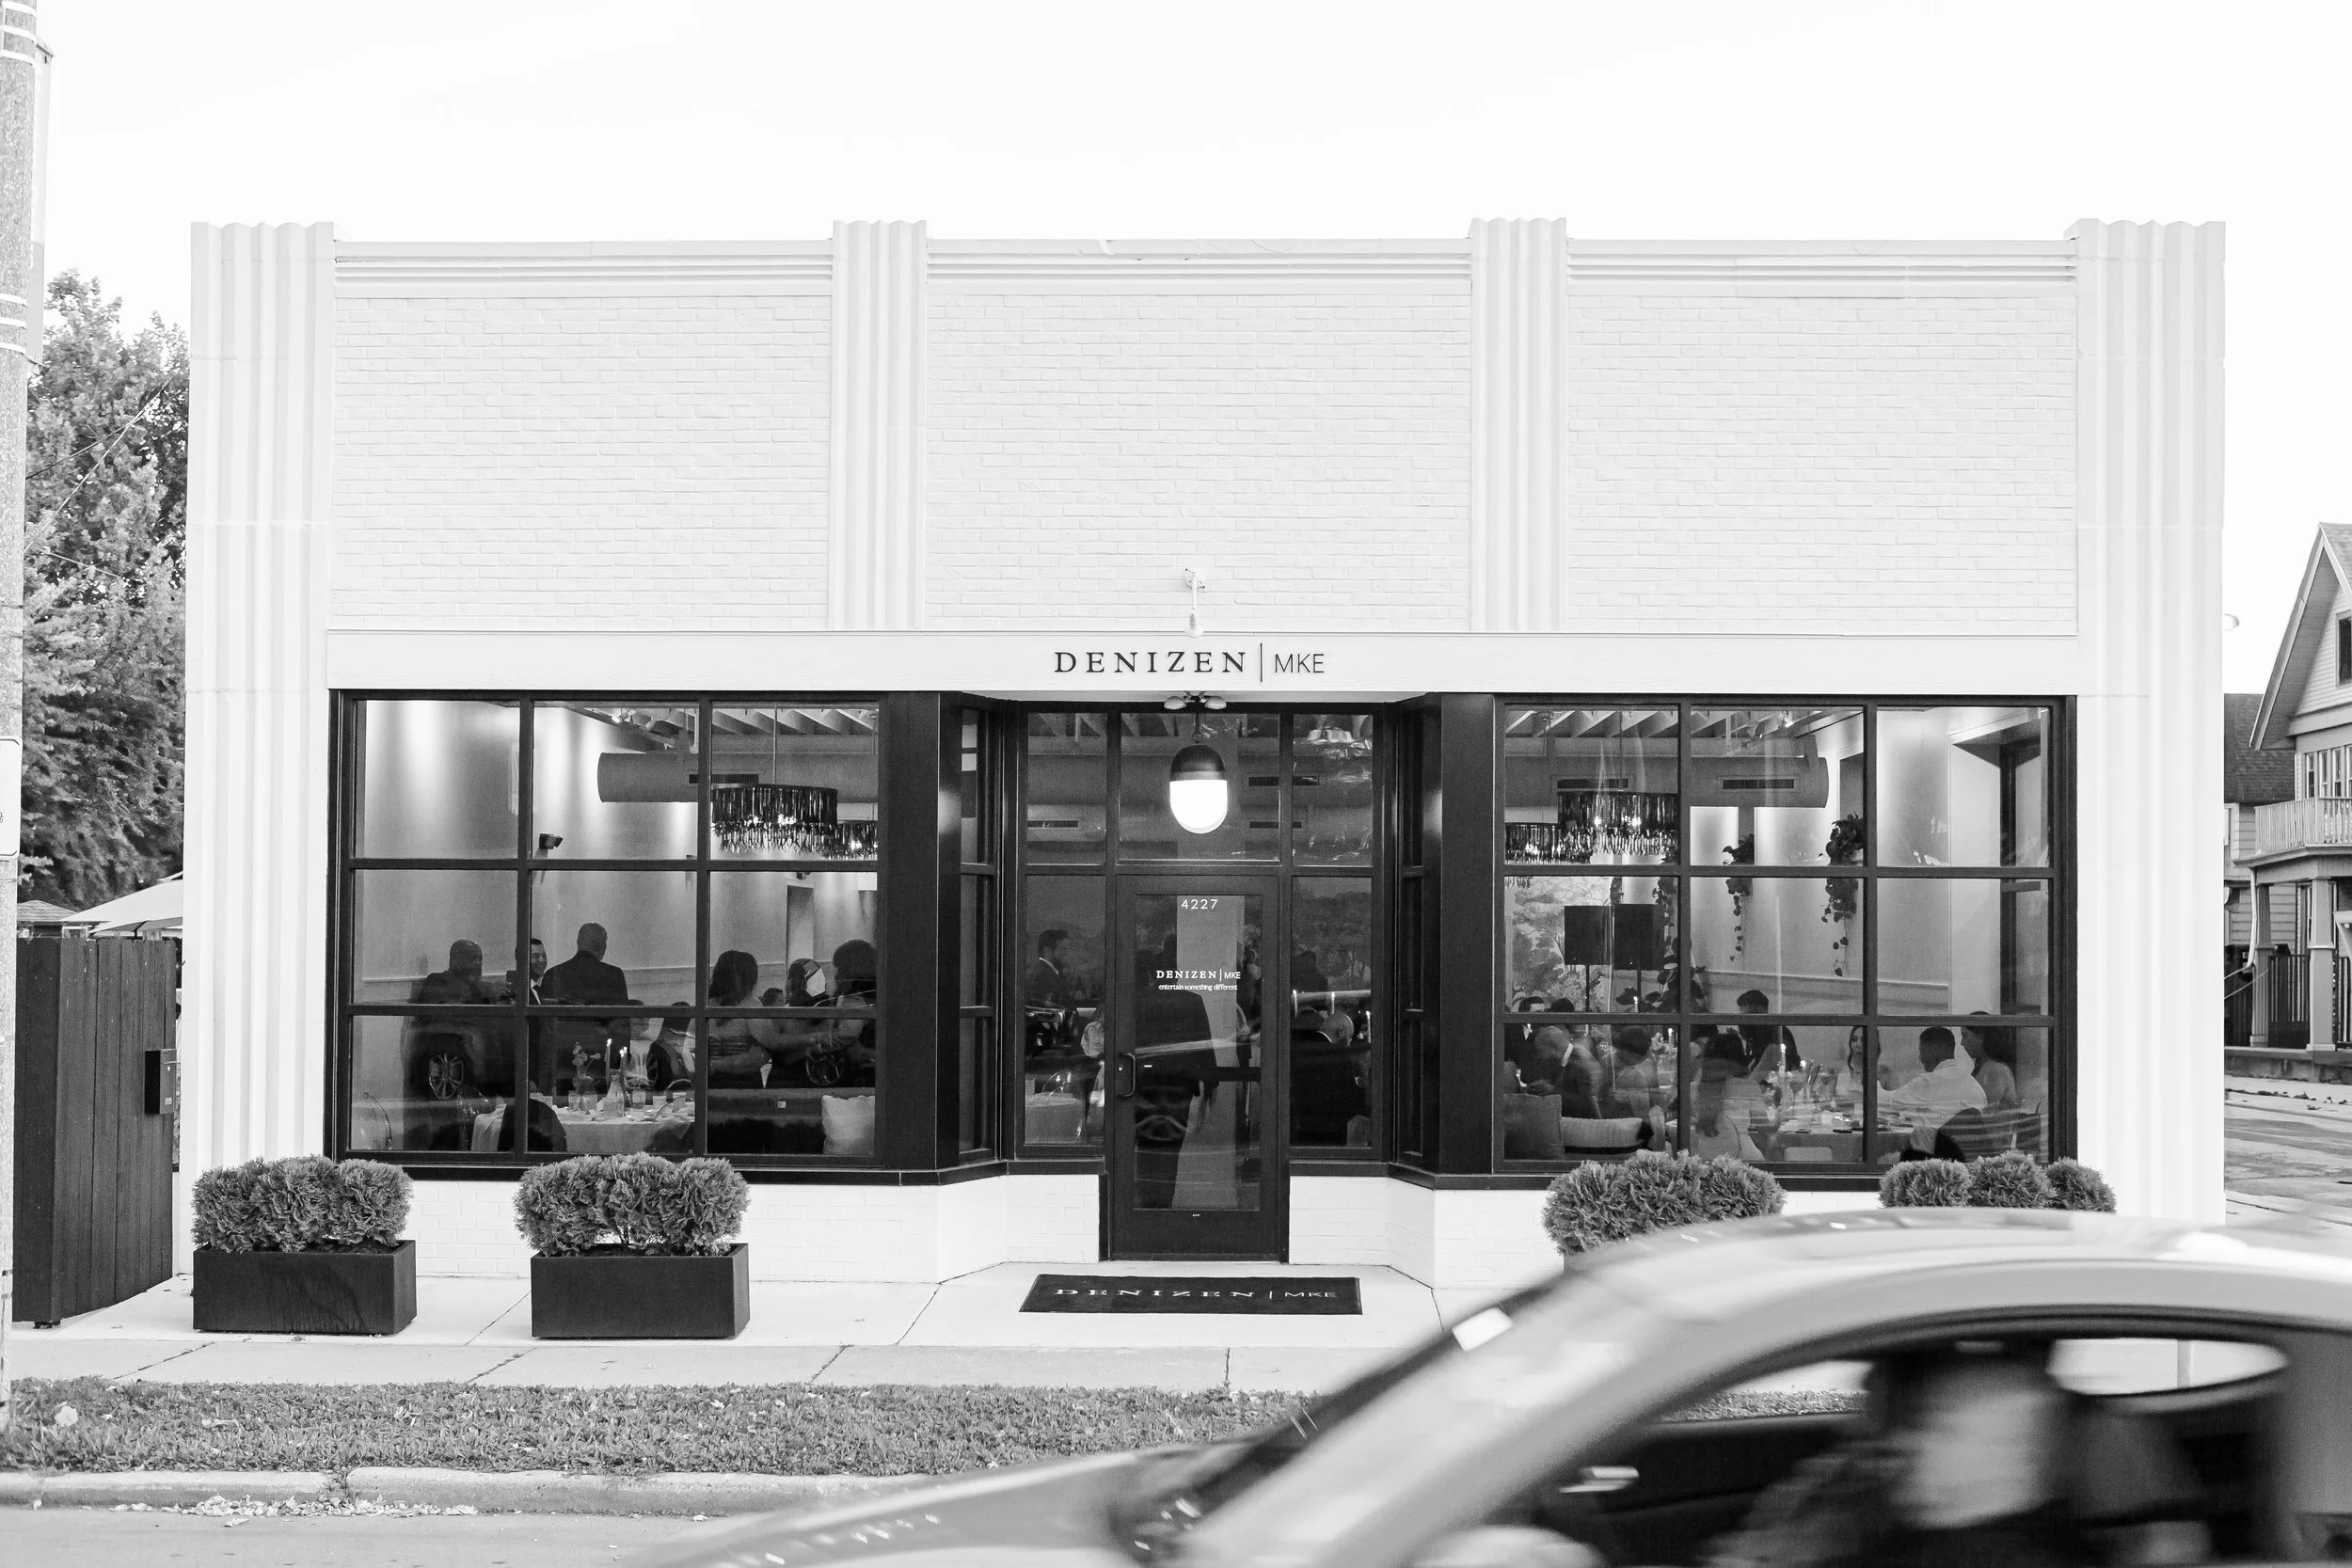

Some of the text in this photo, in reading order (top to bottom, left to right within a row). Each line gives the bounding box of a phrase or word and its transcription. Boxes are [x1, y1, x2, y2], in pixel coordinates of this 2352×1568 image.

[1054, 651, 1325, 673] DENIZEN MKE
[1181, 898, 1218, 910] 4227
[1156, 970, 1241, 979] DENIZEN MKE
[1054, 1289, 1338, 1299] DENIZEN MKE
